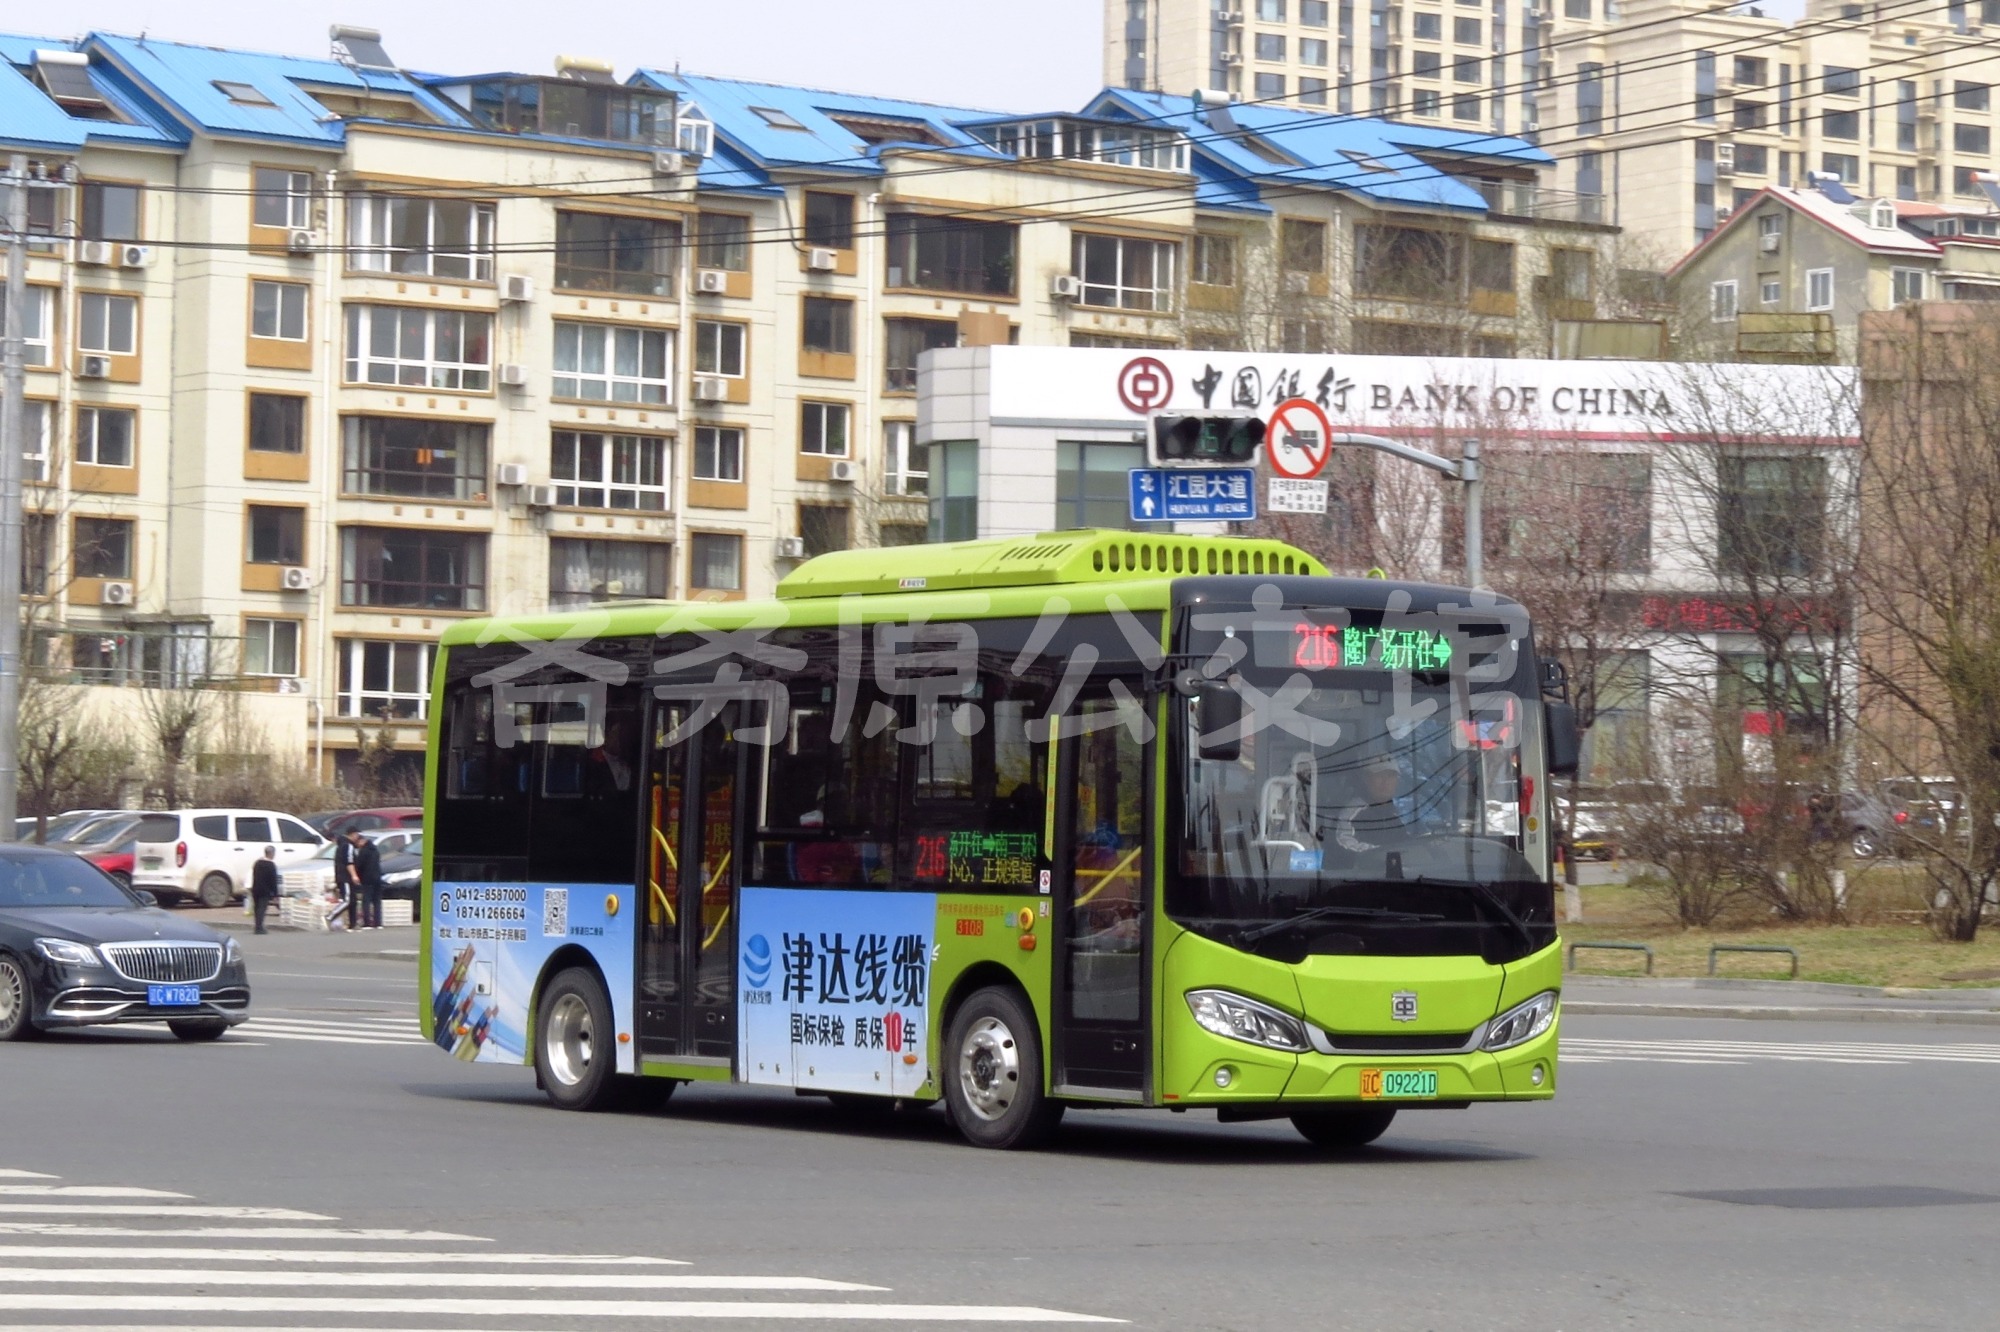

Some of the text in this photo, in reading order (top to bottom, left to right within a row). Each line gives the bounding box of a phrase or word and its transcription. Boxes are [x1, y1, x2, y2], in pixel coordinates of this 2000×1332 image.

[1371, 384, 1674, 415] BANK OF CHINA
[1140, 473, 1155, 494] 北
[1168, 475, 1248, 500] 汇园大道
[1213, 501, 1248, 514] AVENUE
[1294, 623, 1339, 668] 216
[916, 835, 946, 878] 216
[455, 887, 527, 902] 0412-8587000
[456, 906, 526, 921] 18741266664
[957, 919, 983, 937] 3108
[782, 932, 927, 1008] 津达线缆
[791, 1011, 917, 1053] 国标保检 质保10年
